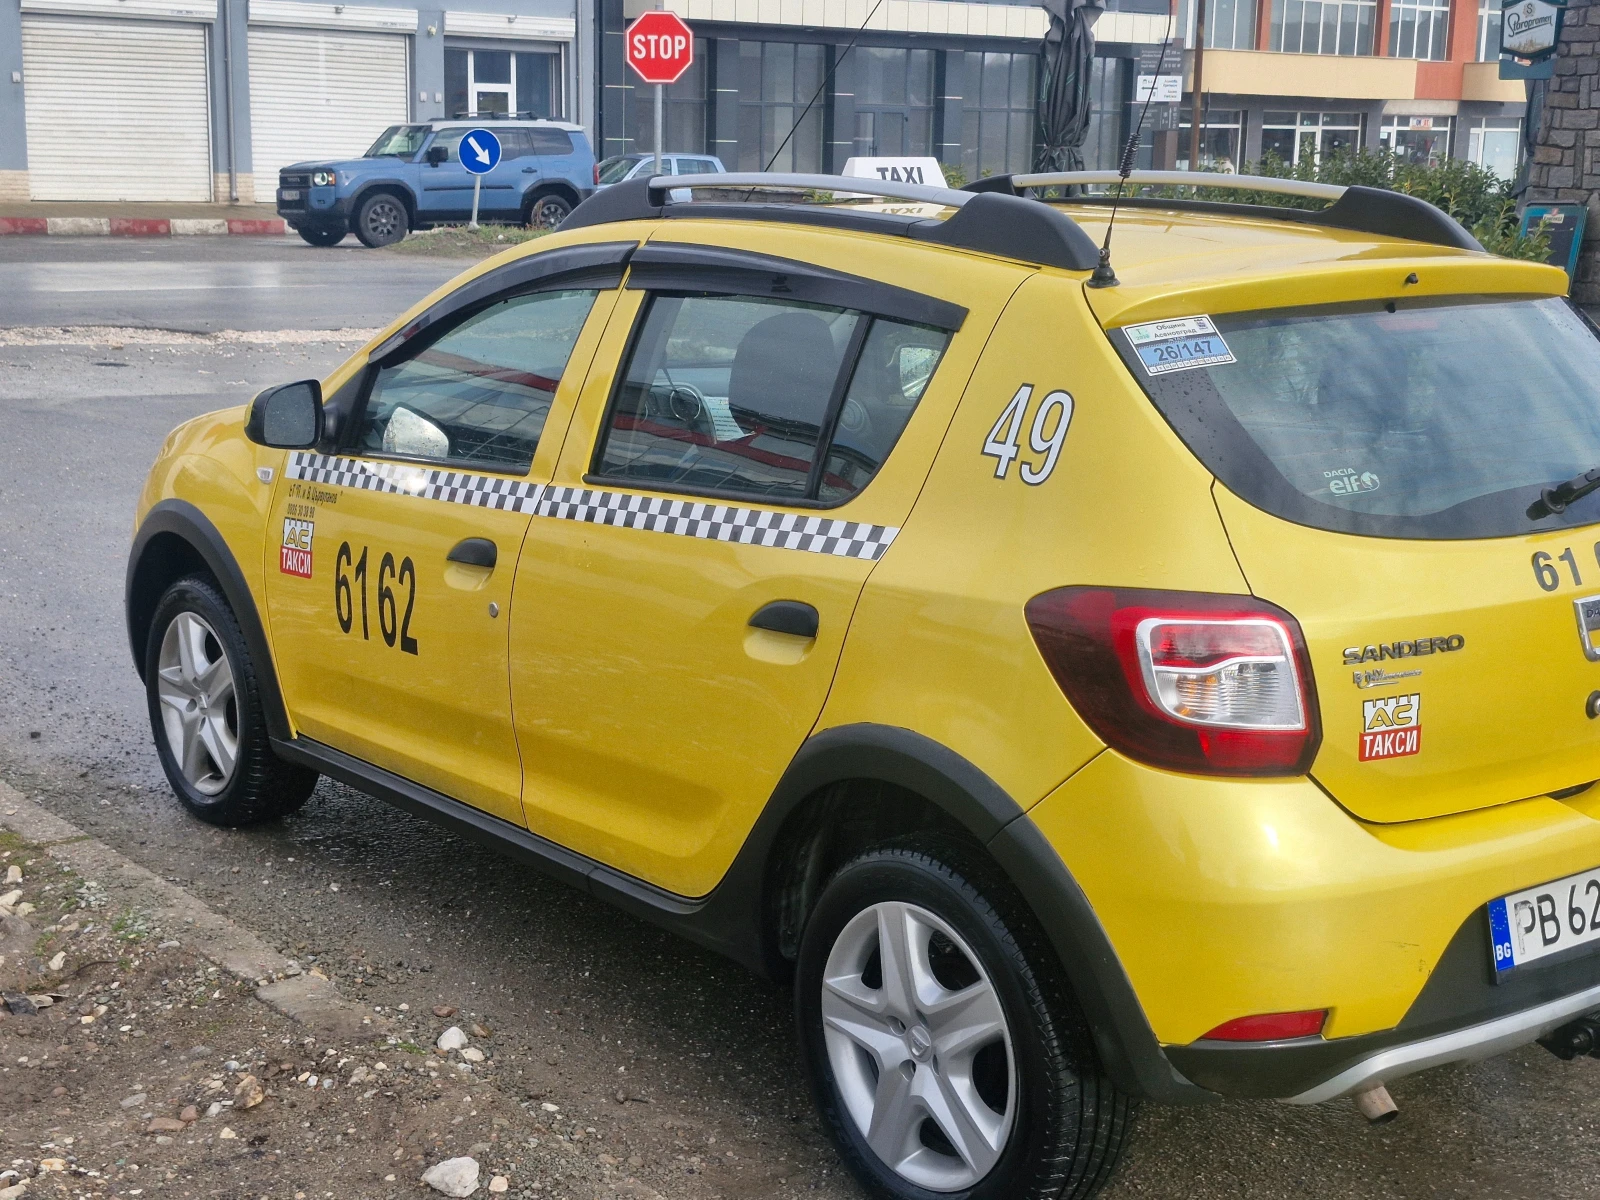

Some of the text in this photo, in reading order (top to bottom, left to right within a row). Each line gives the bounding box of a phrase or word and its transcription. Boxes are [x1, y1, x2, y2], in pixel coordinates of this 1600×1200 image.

[1508, 12, 1554, 37] Staropramen
[633, 34, 686, 59] STOP
[876, 166, 925, 184] TAXI
[1156, 322, 1186, 331] Община
[1153, 340, 1213, 361] 26/147
[980, 382, 1075, 487] 49
[1323, 467, 1356, 478] DACIA
[1330, 475, 1360, 494] elf
[282, 548, 311, 575] ТАКСИ
[1531, 547, 1583, 592] 61
[1342, 634, 1465, 665] SANDERO
[1363, 730, 1418, 758] ТАКСИ
[1514, 879, 1600, 955] PB 62
[1495, 942, 1512, 961] BG
